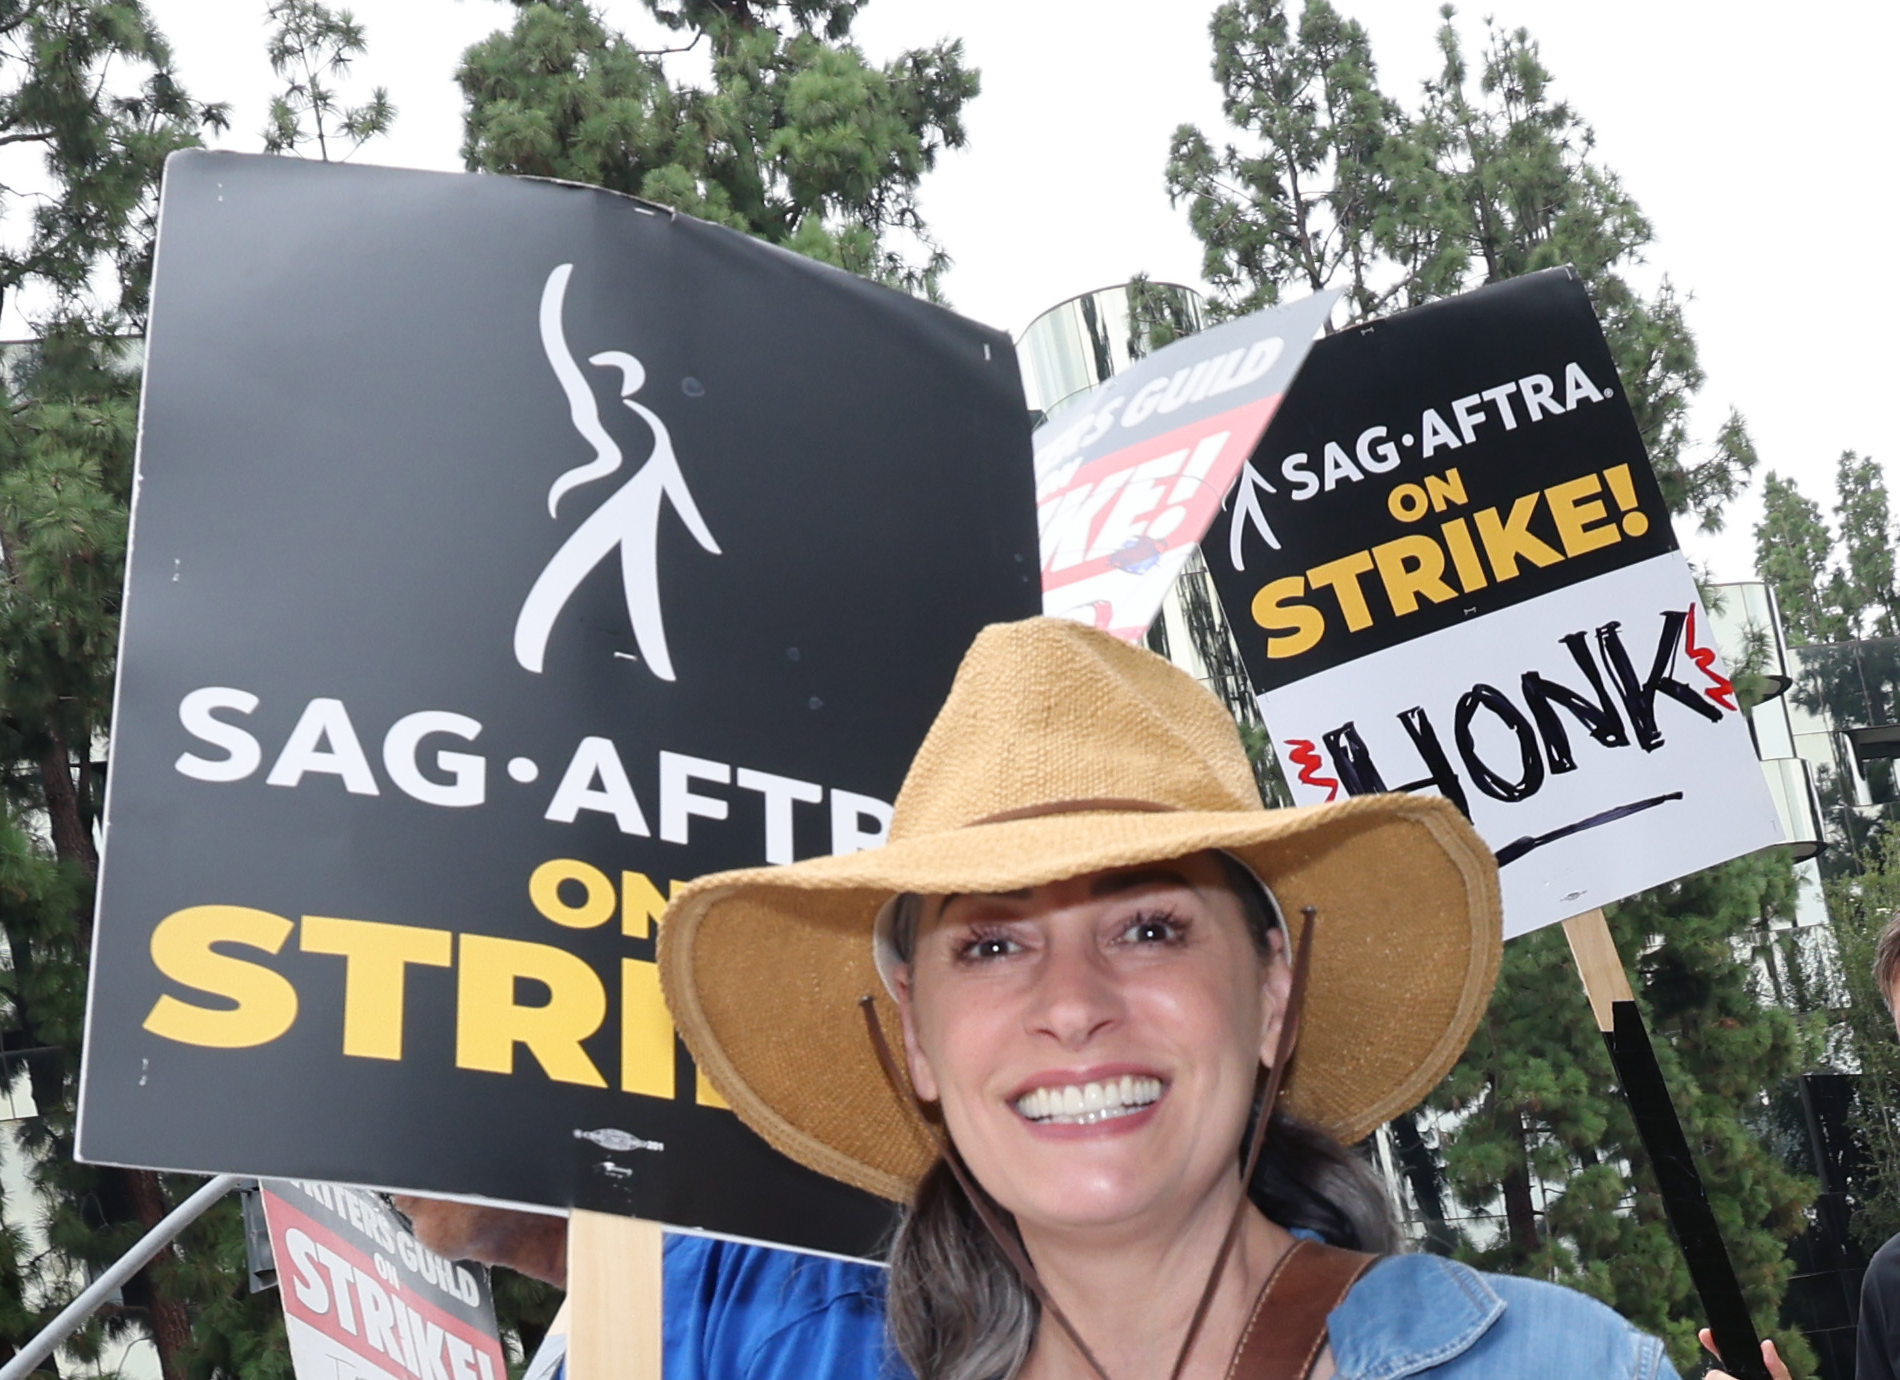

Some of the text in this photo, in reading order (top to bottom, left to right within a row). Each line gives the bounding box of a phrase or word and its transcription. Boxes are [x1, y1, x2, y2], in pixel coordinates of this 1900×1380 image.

[1121, 336, 1285, 428] GUILD
[1387, 467, 1468, 524] ON
[1251, 463, 1651, 660] STRIKE!
[1320, 611, 1723, 826] HONK
[373, 1252, 400, 1290] ON
[395, 1230, 480, 1308] GUILD
